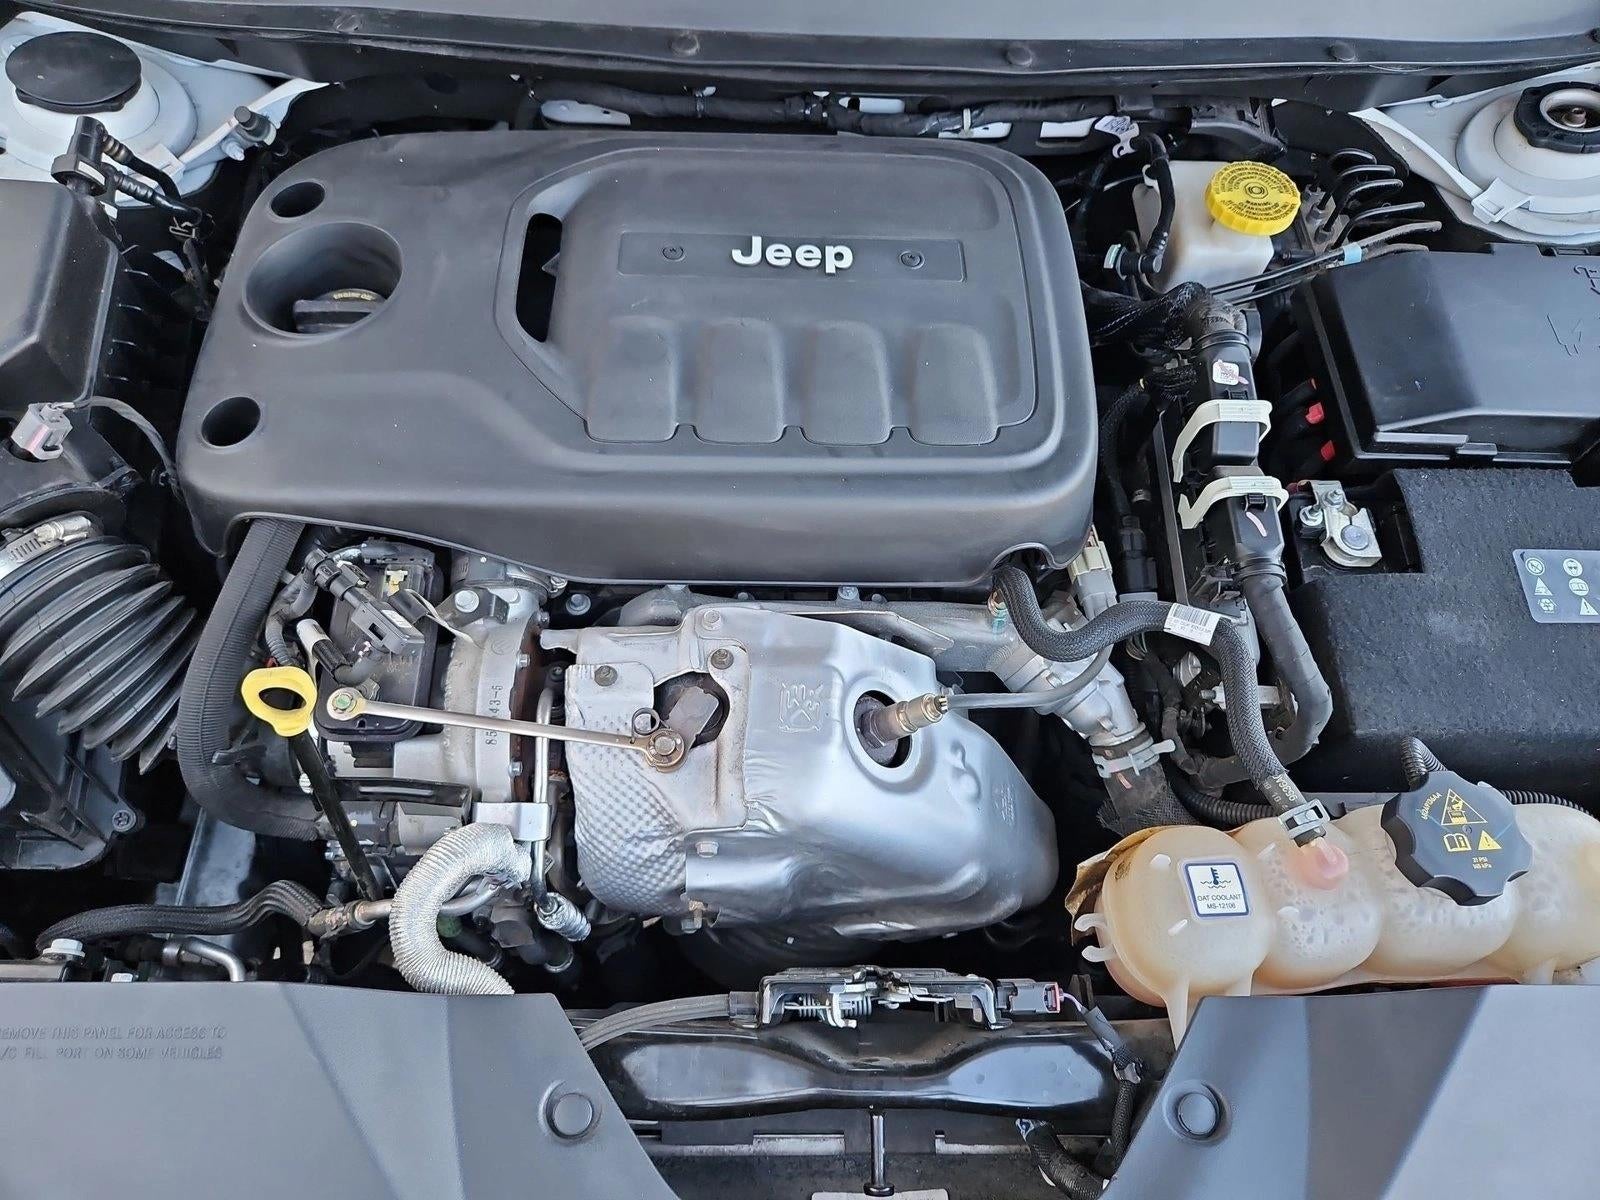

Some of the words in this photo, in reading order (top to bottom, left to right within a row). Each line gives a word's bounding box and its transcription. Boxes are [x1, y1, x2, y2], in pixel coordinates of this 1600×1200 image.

[731, 236, 853, 274] Jeep
[485, 684, 503, 746] 8543-5
[1211, 893, 1241, 901] COOLANT
[0, 1025, 47, 1040] EMOVE
[51, 1025, 80, 1040] THIS
[82, 1026, 122, 1040] PANEL
[127, 1026, 153, 1040] FOR
[154, 1026, 207, 1040] ACCESS
[209, 1025, 226, 1040] TO
